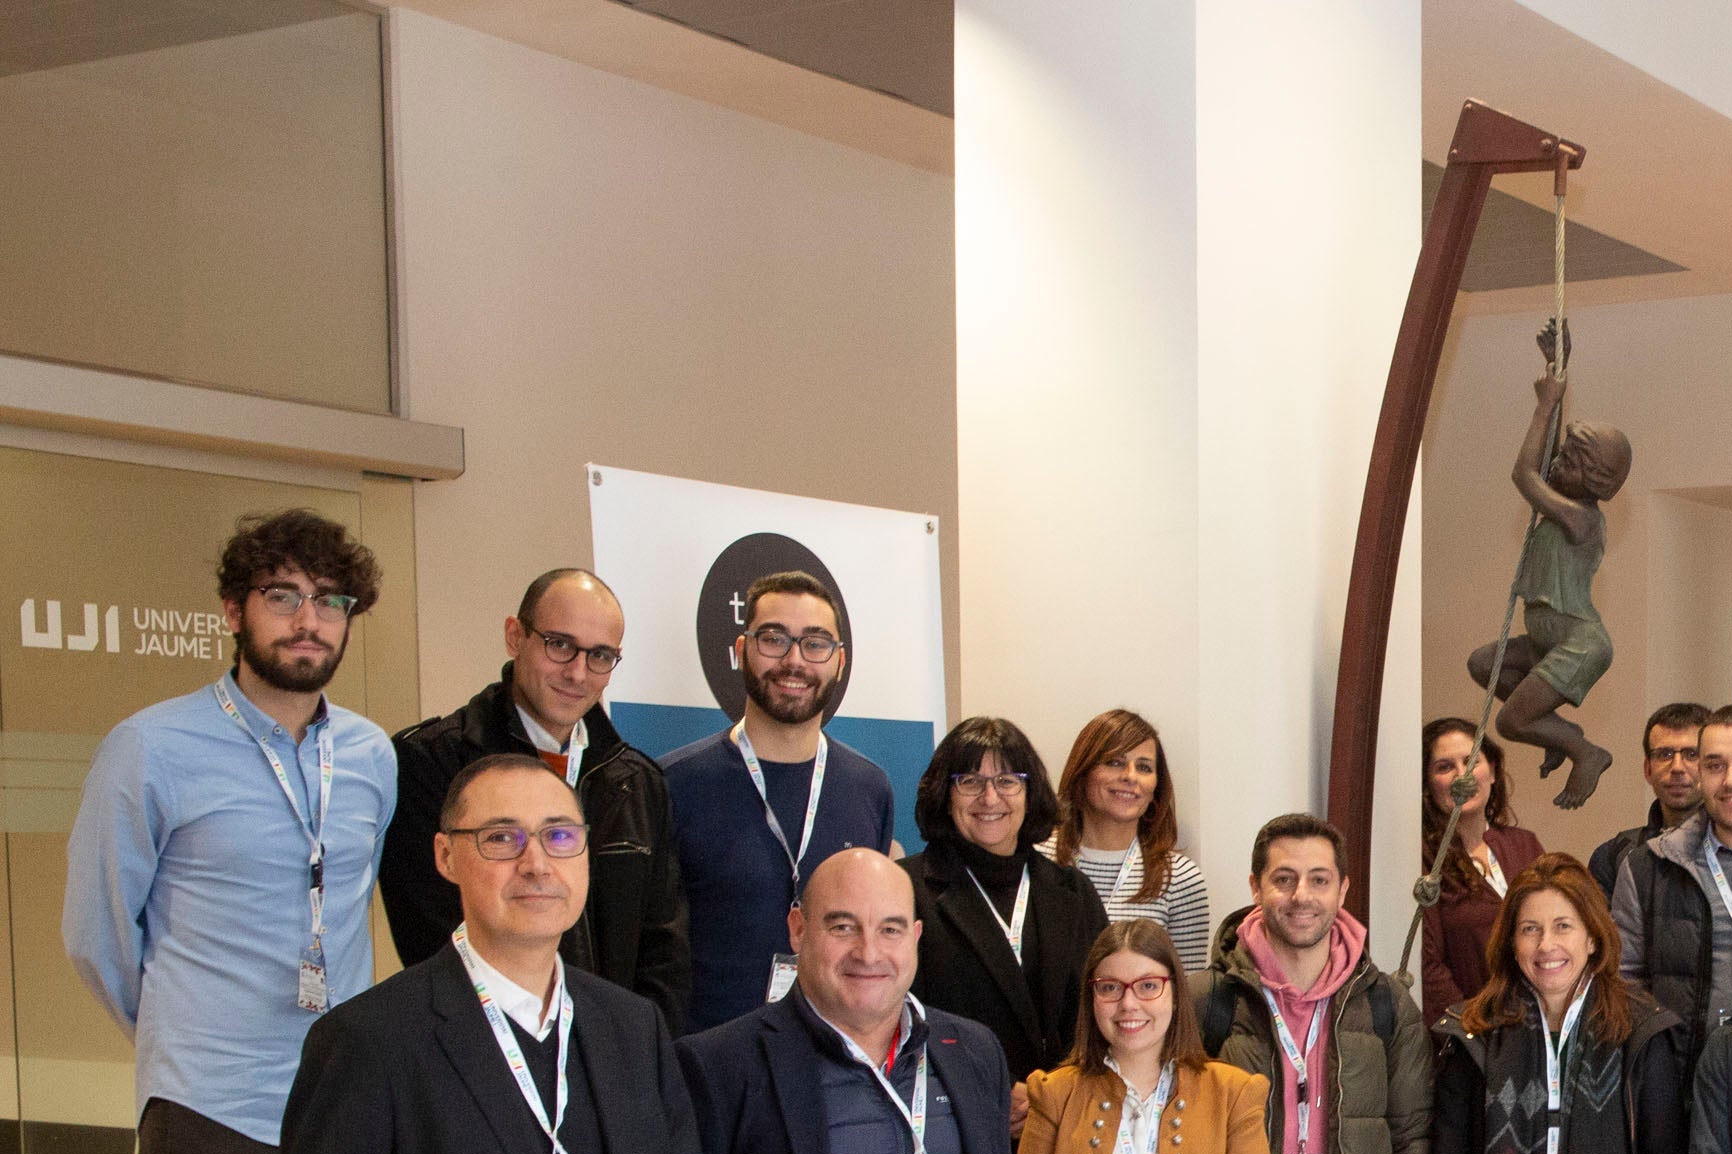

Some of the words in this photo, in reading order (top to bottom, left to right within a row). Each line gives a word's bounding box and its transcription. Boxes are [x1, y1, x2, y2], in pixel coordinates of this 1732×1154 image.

[133, 607, 235, 636] UNIVERS
[134, 633, 211, 660] JAUME
[216, 639, 223, 660] I
